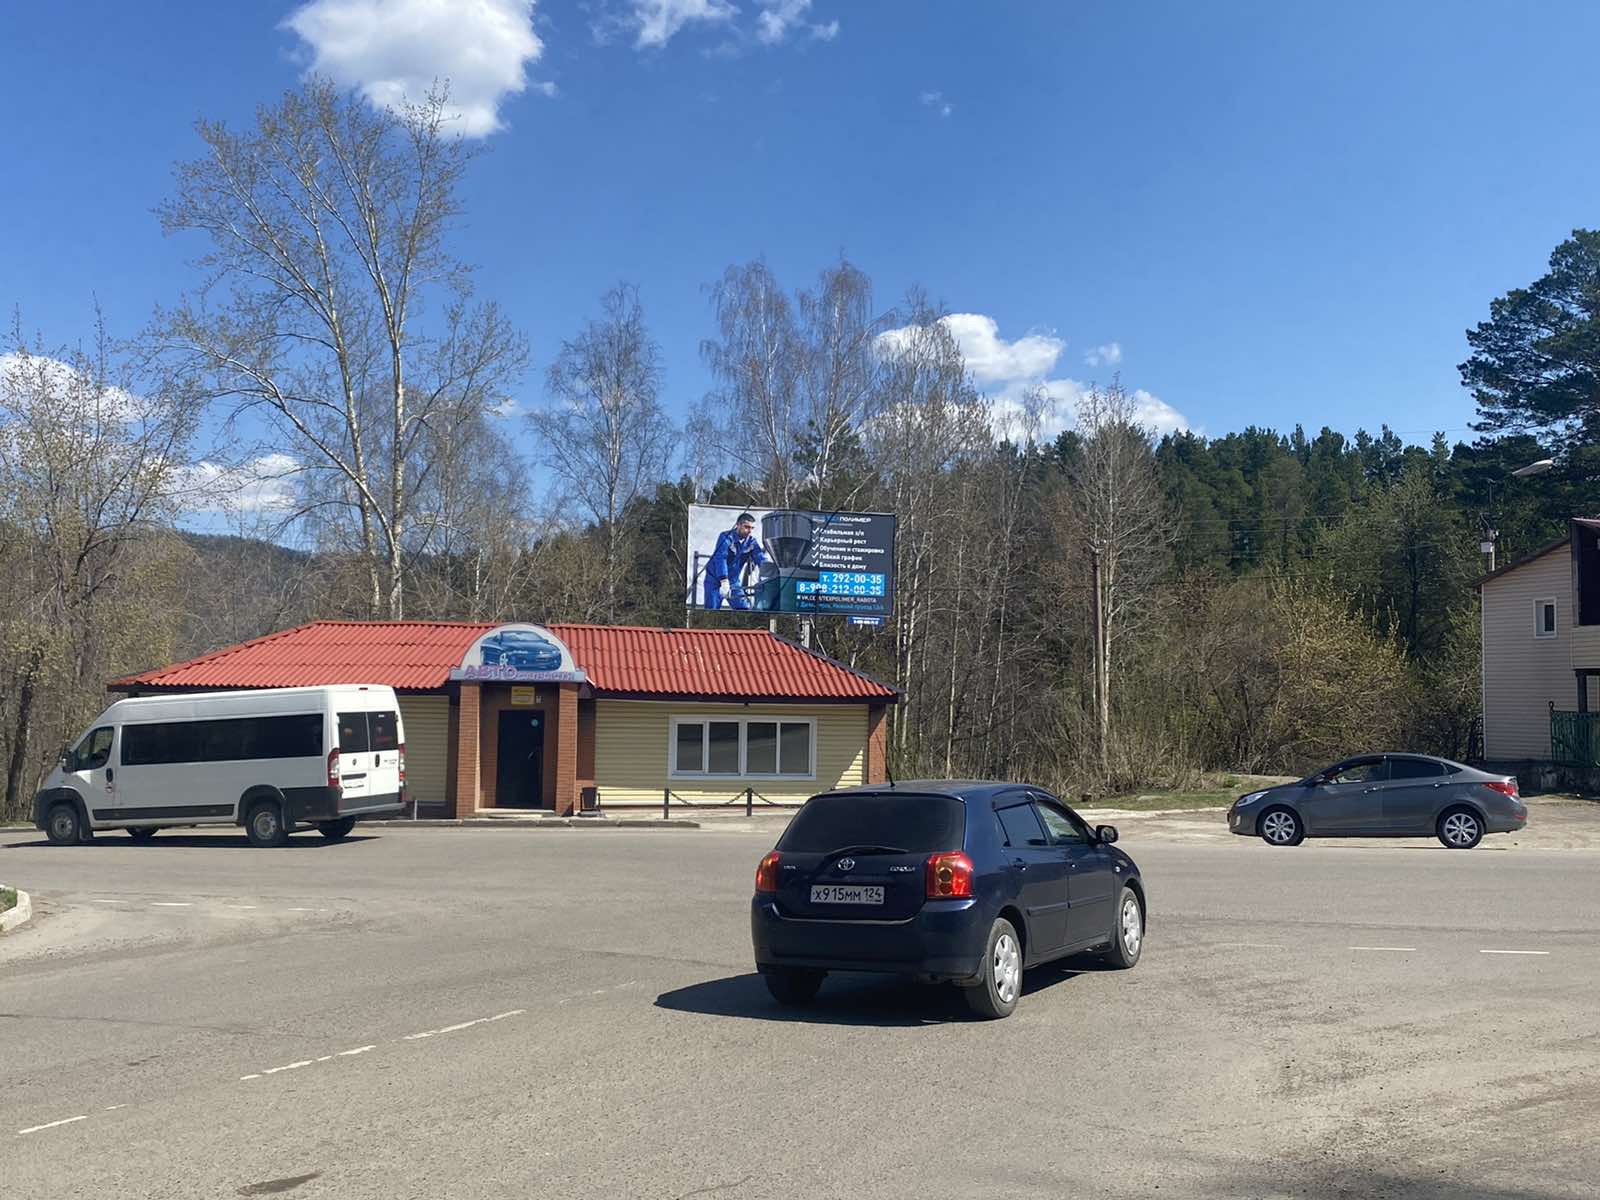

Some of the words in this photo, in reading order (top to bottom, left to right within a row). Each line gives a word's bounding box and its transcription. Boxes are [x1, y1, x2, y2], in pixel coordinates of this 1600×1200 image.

[819, 537, 853, 545] Карьерный
[819, 561, 846, 569] Близость
[832, 573, 882, 584] 292-00-35
[464, 665, 518, 680] АВТО
[863, 888, 881, 898] 124
